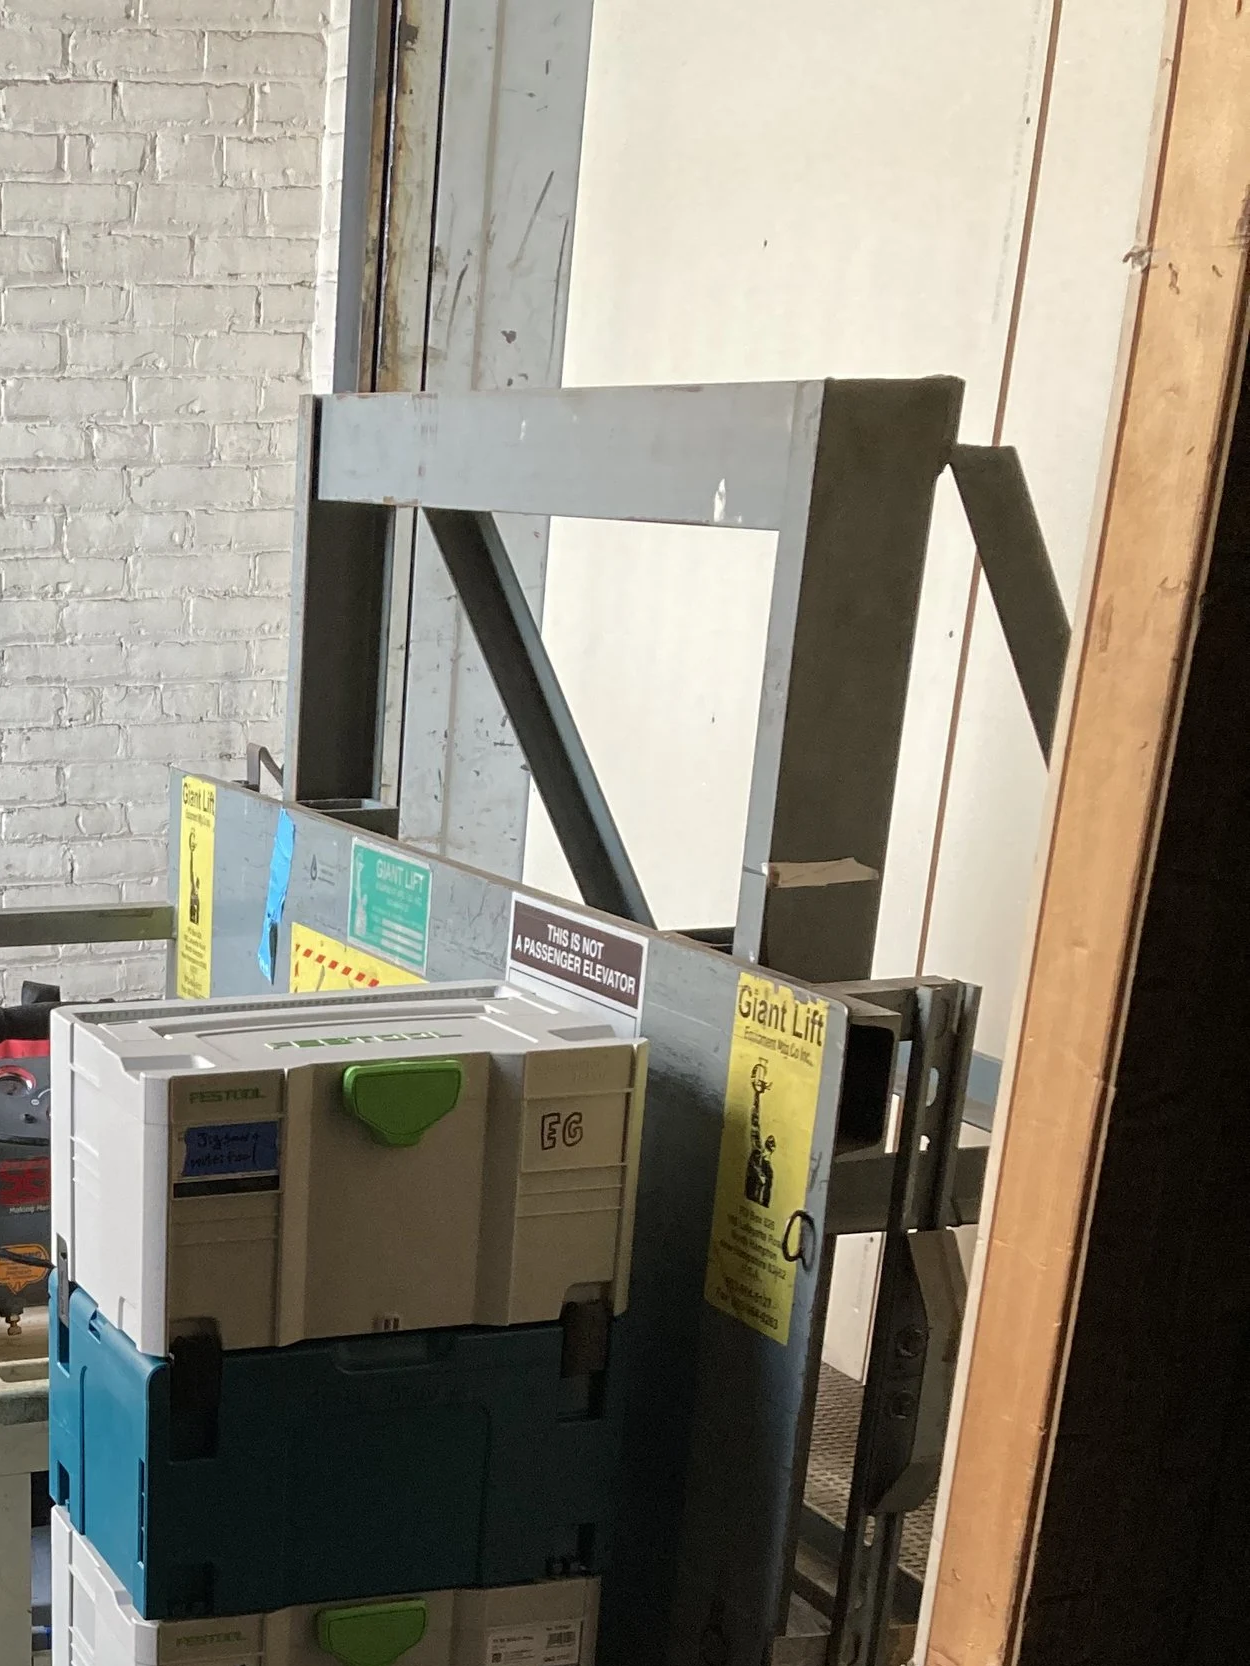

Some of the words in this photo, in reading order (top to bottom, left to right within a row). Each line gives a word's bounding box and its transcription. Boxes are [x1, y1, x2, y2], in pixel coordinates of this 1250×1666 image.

[183, 783, 201, 810] Giant
[203, 789, 215, 815] Lift
[376, 859, 404, 886] GIANT
[405, 870, 425, 893] LIFT
[547, 924, 569, 948] THIS
[571, 933, 581, 951] IS
[582, 937, 605, 959] NOT
[515, 934, 522, 952] A
[524, 937, 581, 975] PASSENGER
[583, 959, 636, 995] ELEVATOR
[739, 985, 787, 1033] Giant
[793, 1003, 823, 1046] Lift
[265, 1032, 462, 1050] FESTOOL
[190, 1088, 266, 1104] FESTOOL
[541, 1112, 583, 1151] EG
